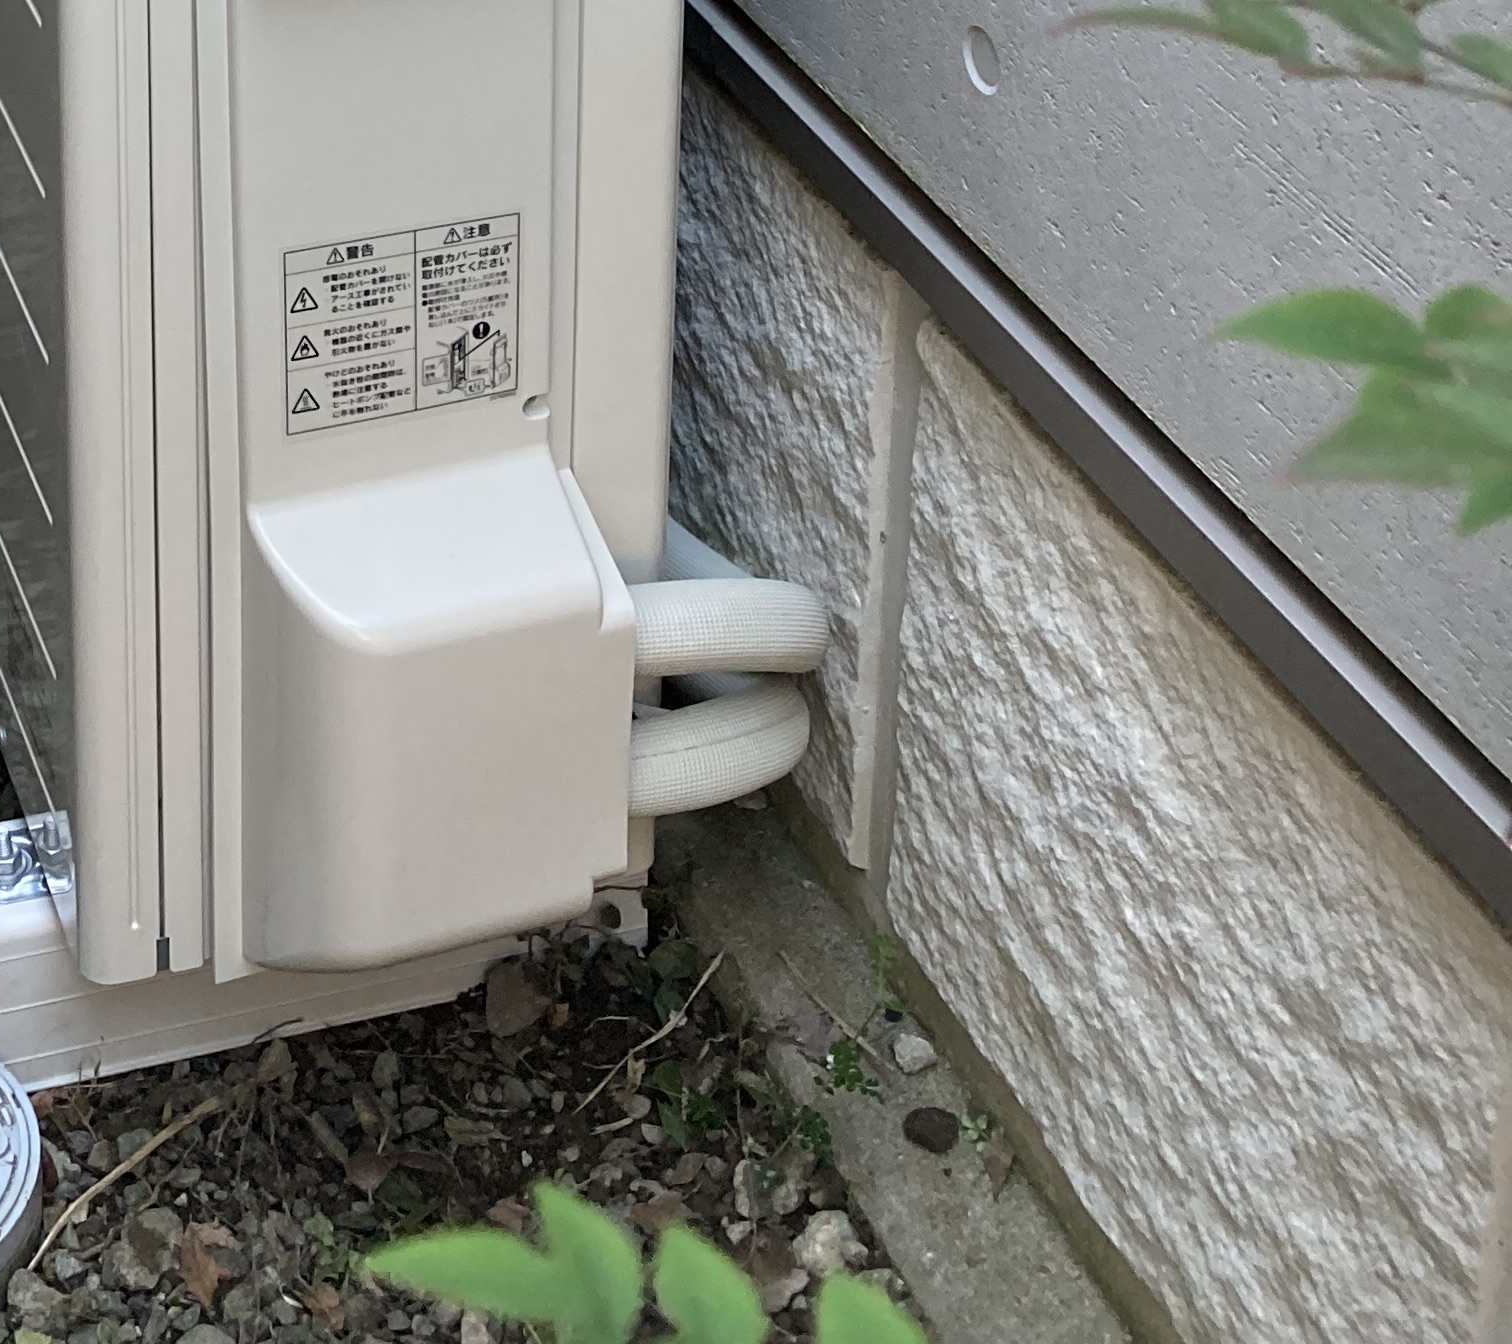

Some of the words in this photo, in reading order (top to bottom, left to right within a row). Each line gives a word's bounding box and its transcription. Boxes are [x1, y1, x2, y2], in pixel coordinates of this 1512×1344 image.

[463, 223, 490, 239] 注意
[346, 244, 374, 260] 警告
[421, 242, 513, 268] 配管カバーは必ず
[422, 257, 511, 280] 取付けてください
